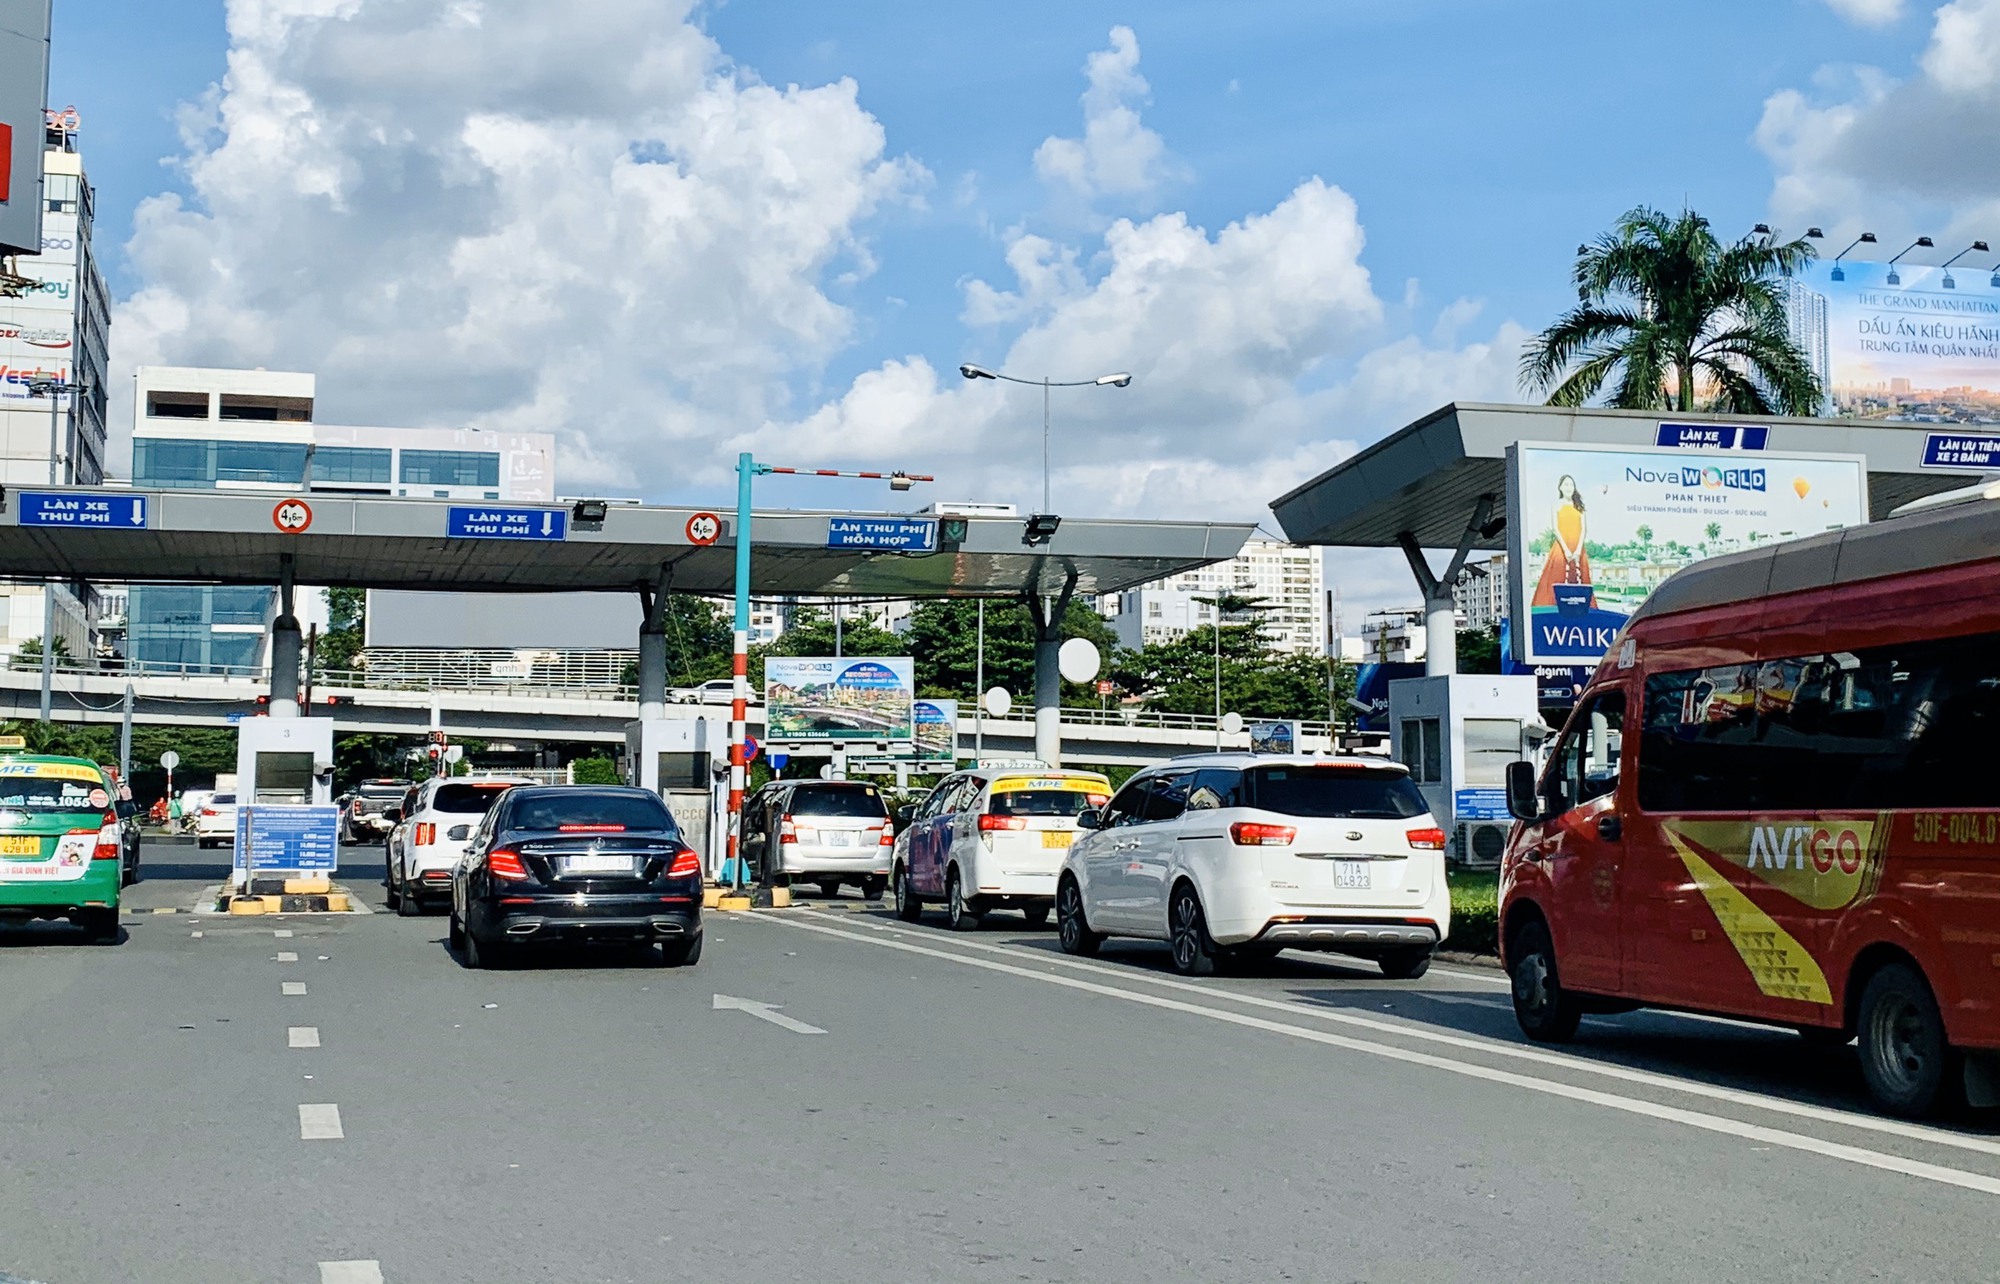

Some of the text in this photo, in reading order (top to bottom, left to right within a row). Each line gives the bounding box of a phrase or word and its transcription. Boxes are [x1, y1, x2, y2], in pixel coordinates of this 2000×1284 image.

[1857, 293, 1999, 314] THE GRAND MANHATTAN
[1858, 315, 1999, 342] DẤU ẤN KIÊU HÃNH
[1859, 338, 1999, 359] TRUNG TÂM QUẬN NHẤT
[1679, 428, 1720, 441] LÀN XE
[1938, 438, 1960, 451] LÀN
[1935, 451, 1990, 463] XE 2 BÁNH
[1665, 493, 1728, 503] PHAN THIET
[43, 498, 109, 511] LÀN XE
[38, 512, 111, 522] THU PHÍ
[468, 512, 528, 523] LÀN XE
[463, 524, 530, 534] THU PHÍ
[830, 522, 926, 534] LÀN THU PHÍ
[842, 532, 911, 546] HỖN HỢP
[1492, 687, 1499, 697] 5
[283, 729, 290, 738] 3
[1028, 780, 1063, 789] MPE
[58, 796, 91, 808] 1055
[674, 809, 706, 820] PCCC
[1914, 813, 2000, 844] 50F-004.0
[1342, 863, 1361, 875] 71A
